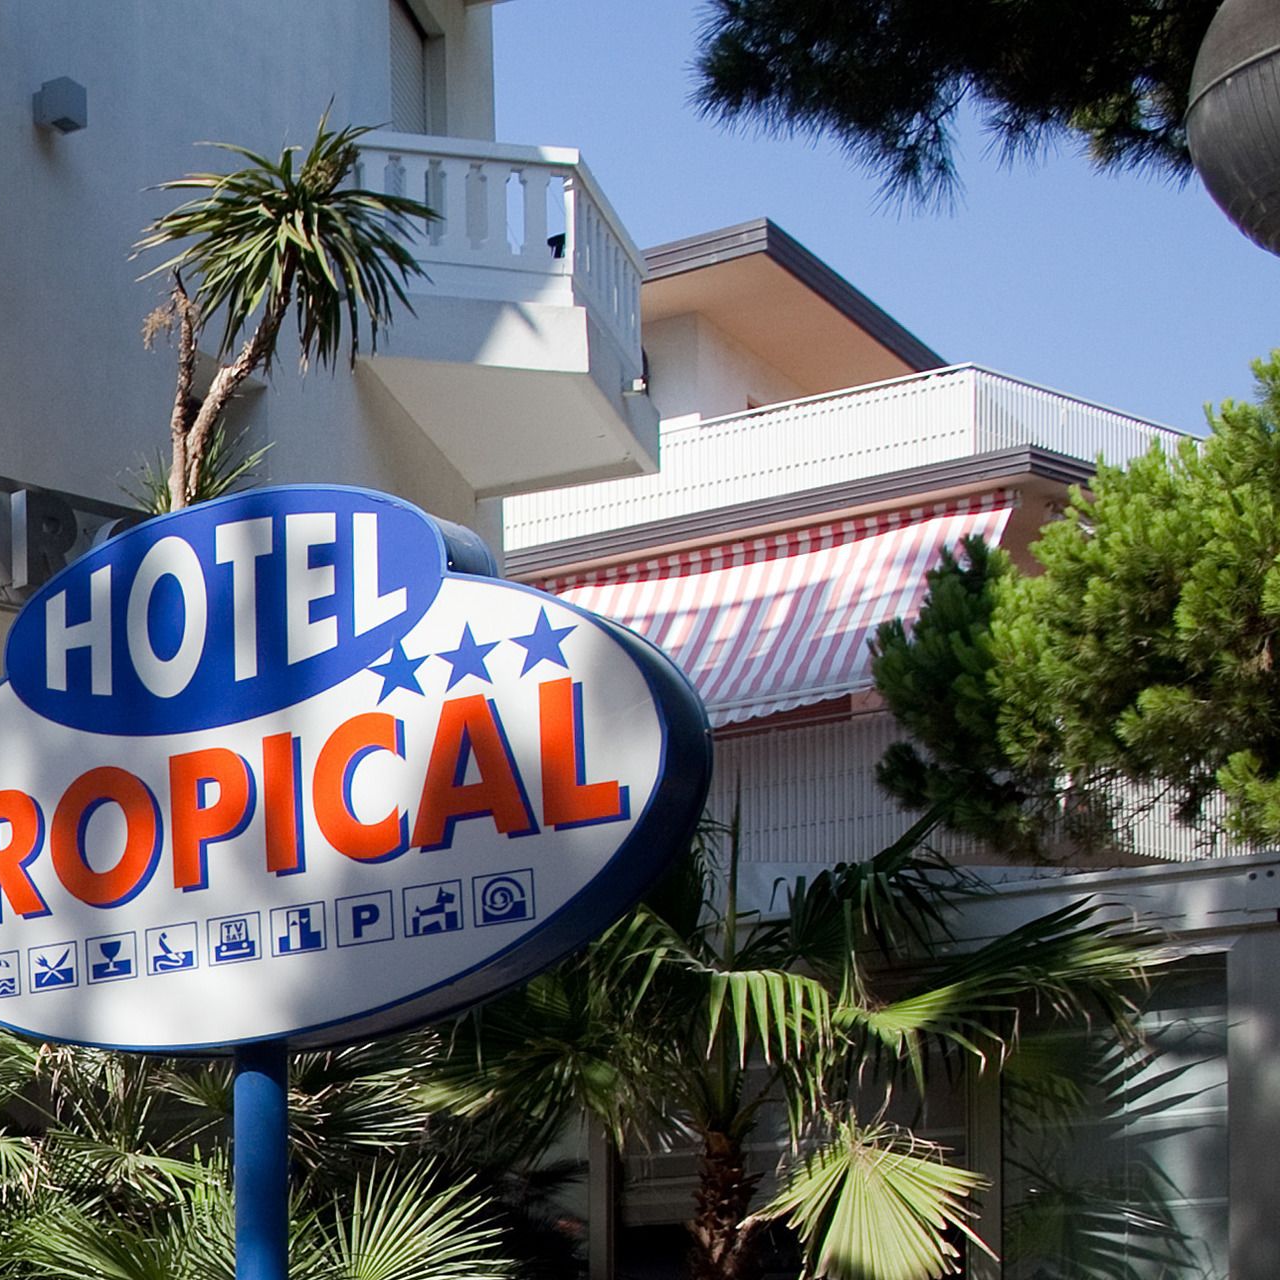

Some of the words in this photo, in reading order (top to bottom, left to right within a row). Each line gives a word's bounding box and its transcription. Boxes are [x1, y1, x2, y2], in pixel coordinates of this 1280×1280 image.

[45, 511, 408, 699] HOTEL
[223, 922, 243, 934] TV
[351, 903, 381, 939] P
